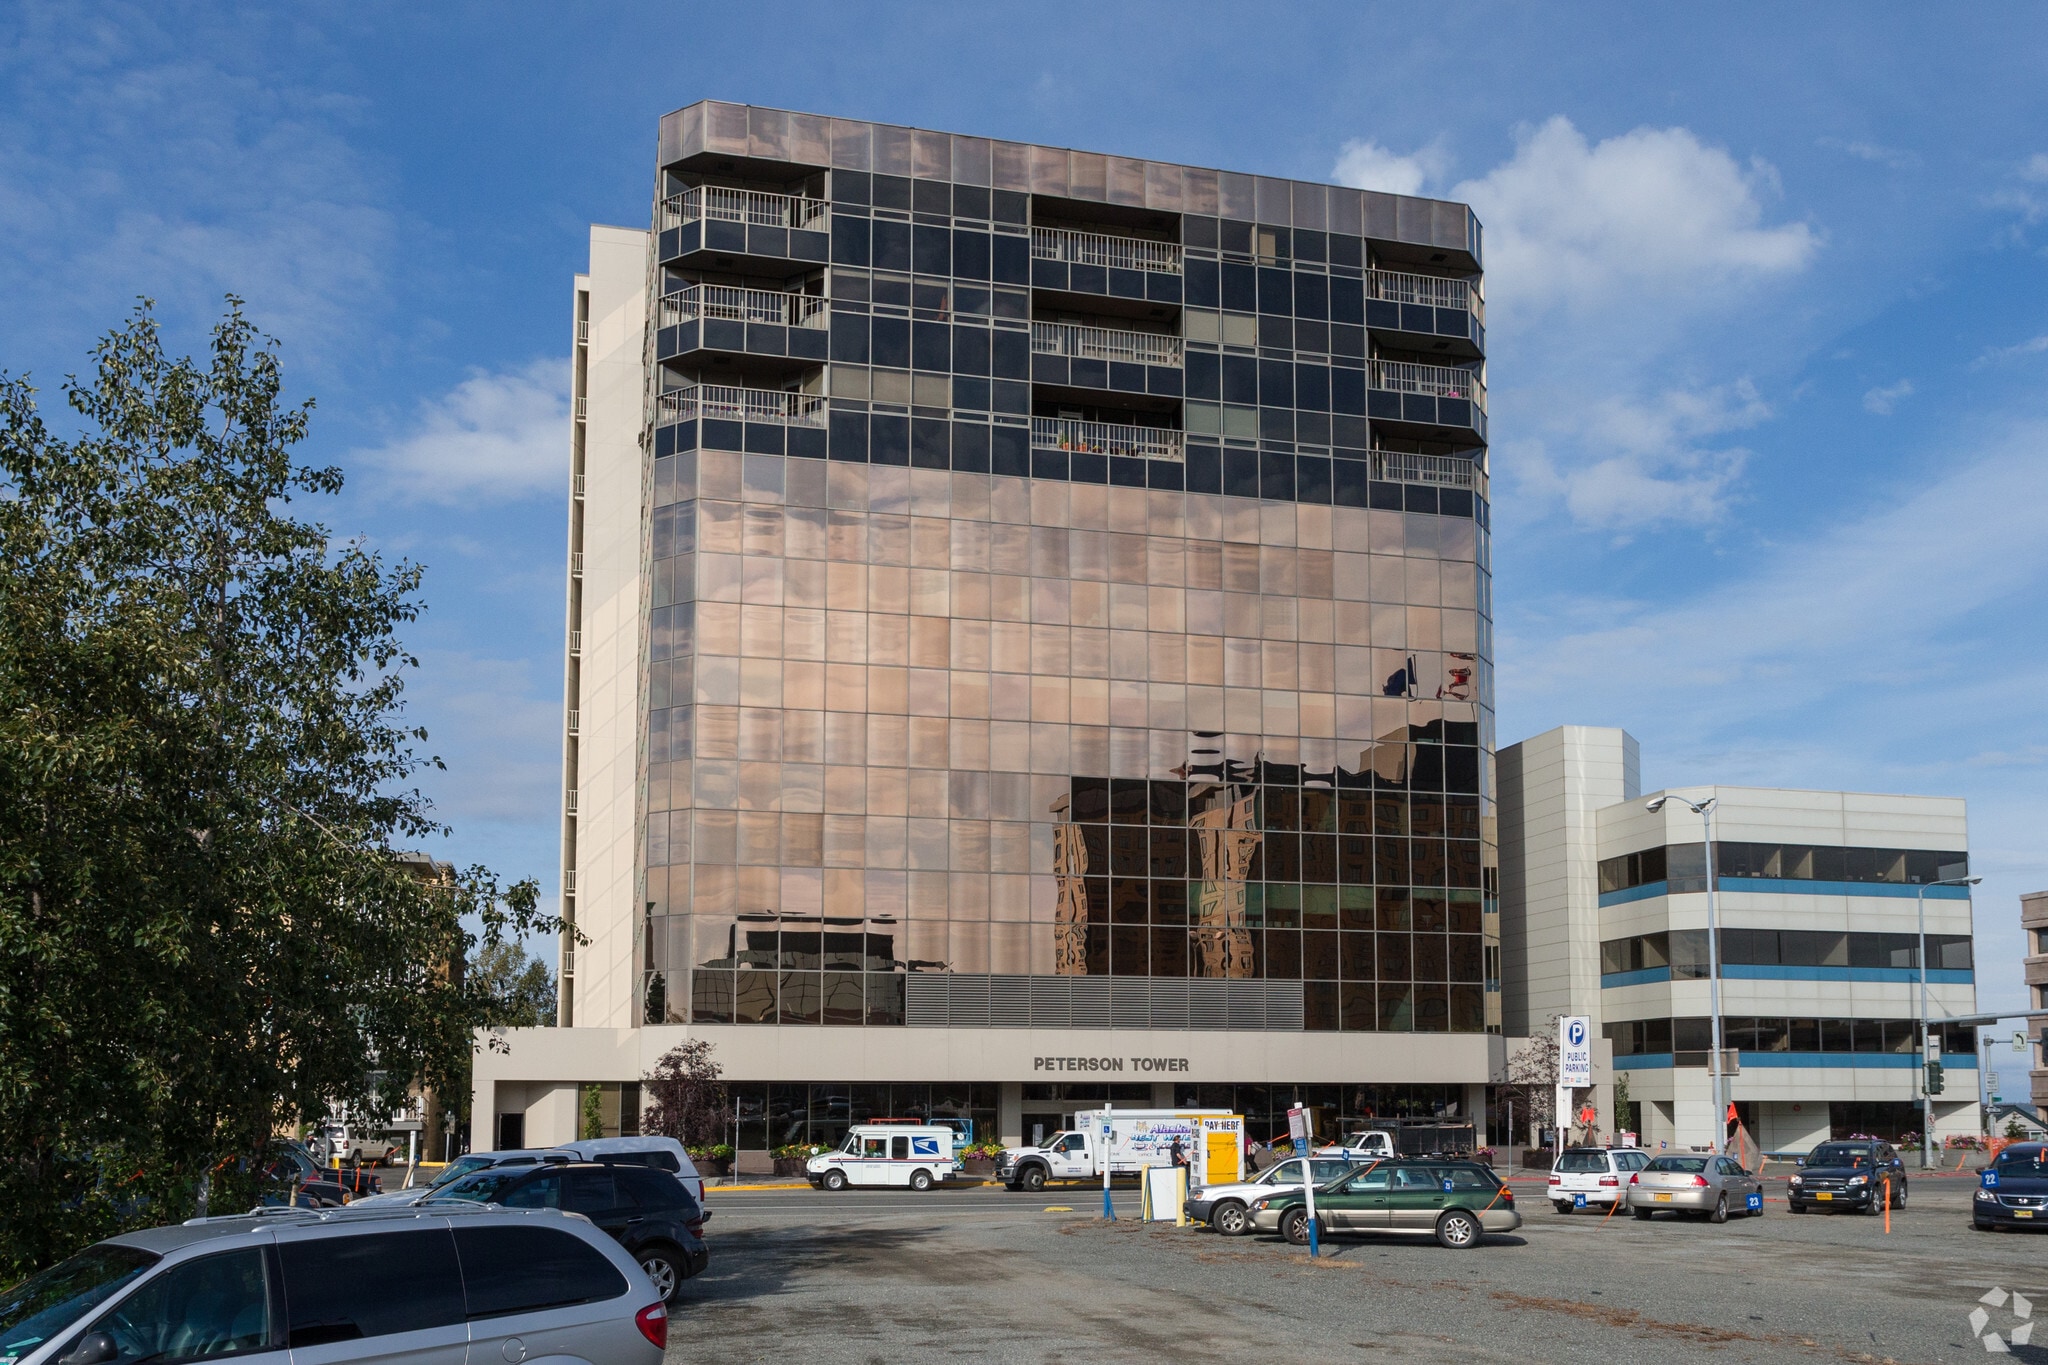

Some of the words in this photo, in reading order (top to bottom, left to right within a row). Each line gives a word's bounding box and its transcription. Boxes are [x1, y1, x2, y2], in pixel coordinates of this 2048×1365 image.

[1567, 1052, 1587, 1062] PUBLIC
[1033, 1057, 1124, 1071] PETERSON
[1130, 1058, 1189, 1072] TOWER
[1565, 1064, 1589, 1073] PARKING
[1149, 1124, 1191, 1134] Alaska
[1204, 1121, 1219, 1130] PAY
[1221, 1120, 1240, 1130] HERE
[1985, 1174, 1996, 1185] 22
[1577, 1197, 1585, 1206] 24
[1749, 1197, 1759, 1206] 23
